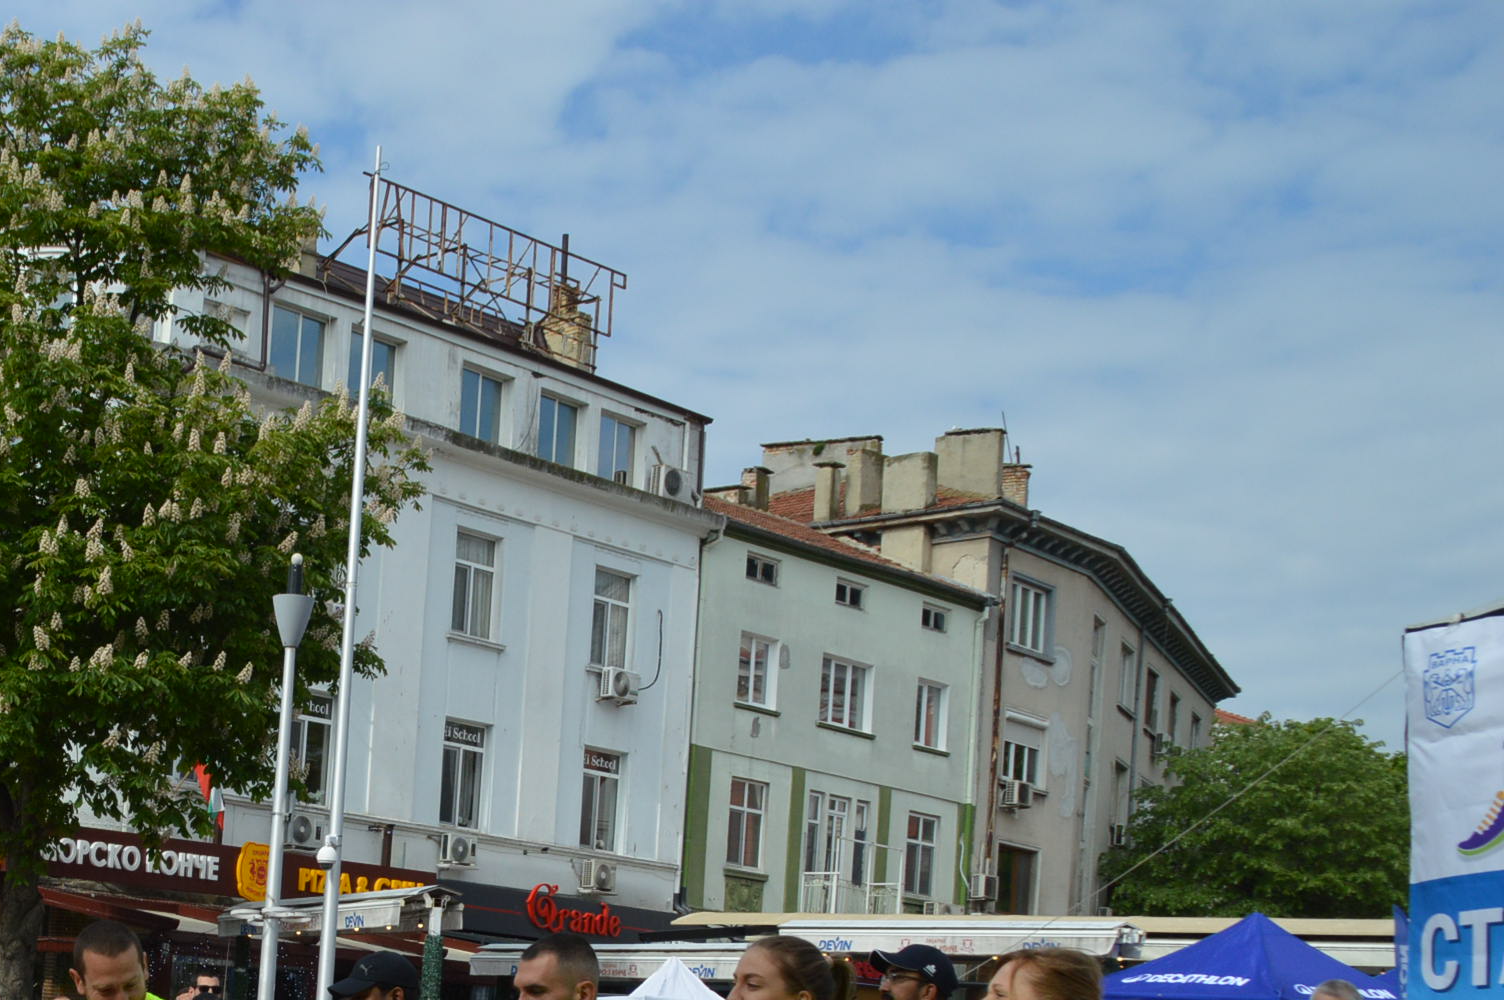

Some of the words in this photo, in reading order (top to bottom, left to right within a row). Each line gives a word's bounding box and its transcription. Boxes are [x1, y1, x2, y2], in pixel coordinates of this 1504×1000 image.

[453, 727, 481, 743] School
[591, 754, 616, 770] School
[298, 867, 352, 894] PIZA
[526, 883, 622, 937] Grande
[818, 937, 852, 951] DEVIN
[1421, 908, 1504, 991] СТ
[1146, 973, 1250, 987] DECATHLON
